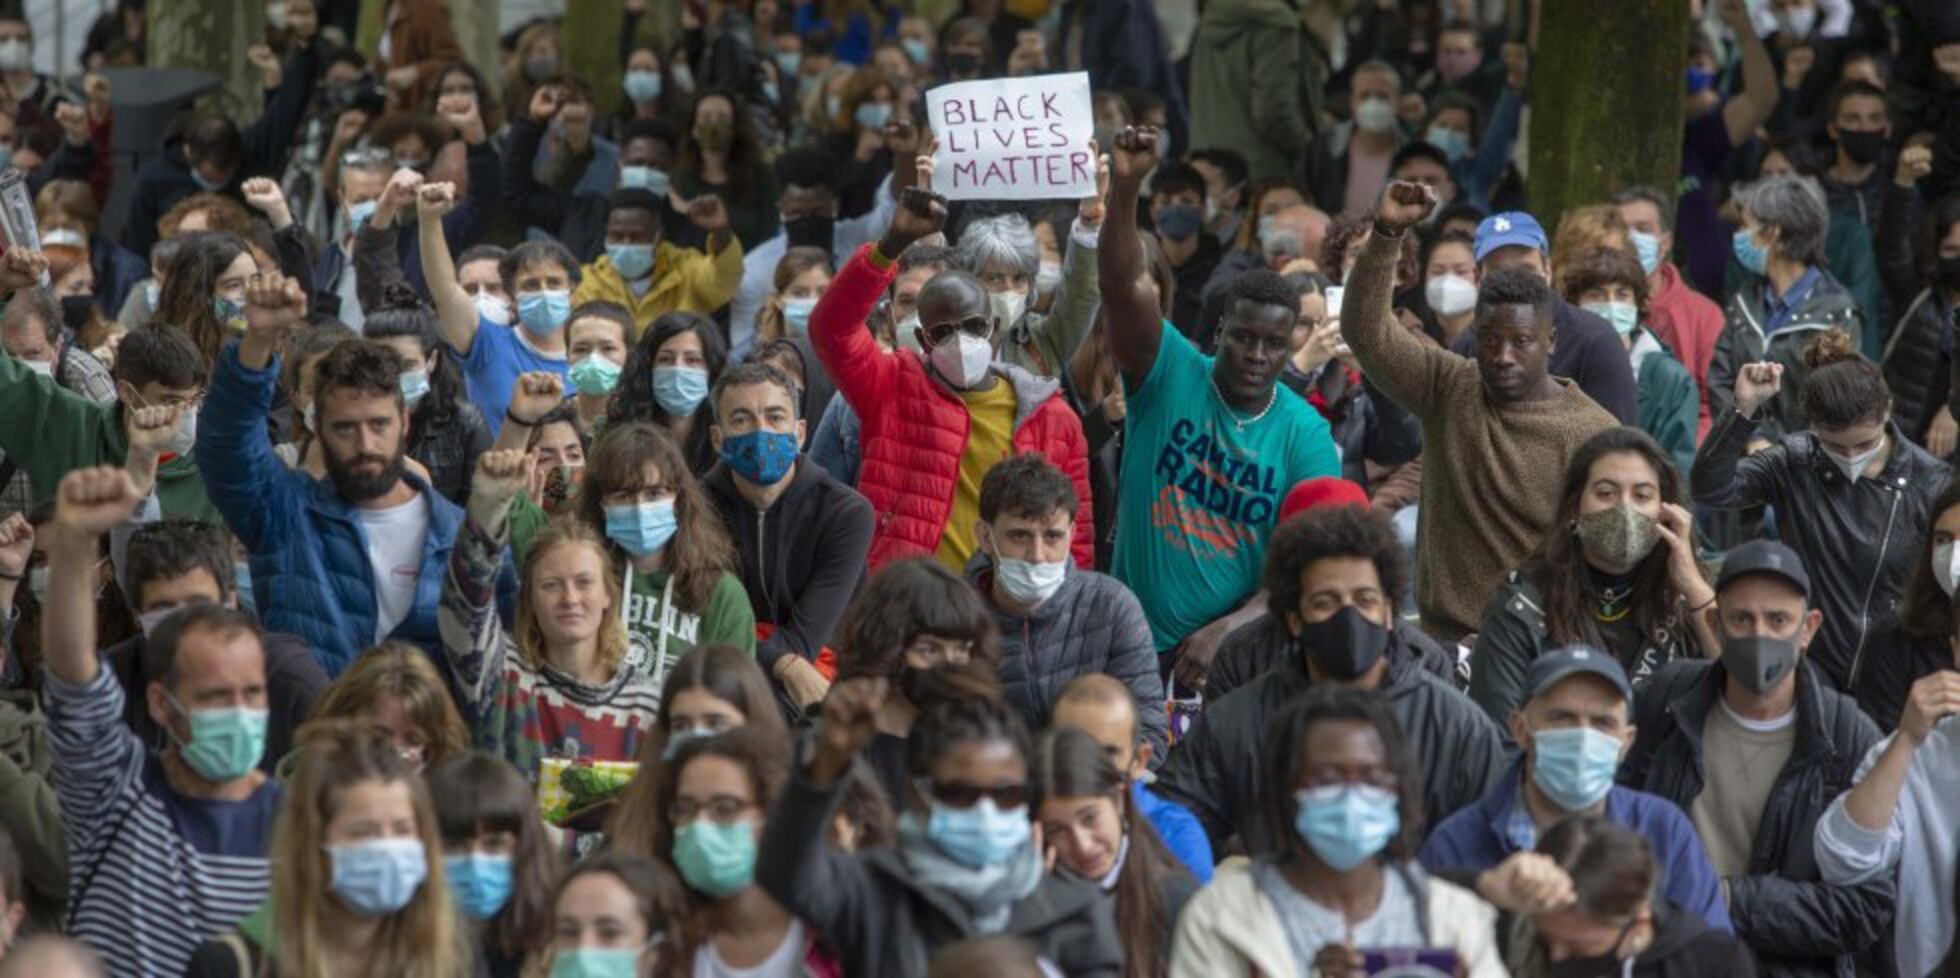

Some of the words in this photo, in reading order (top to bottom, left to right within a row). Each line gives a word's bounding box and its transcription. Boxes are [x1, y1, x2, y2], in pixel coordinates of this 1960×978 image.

[943, 91, 1063, 125] BLACK
[949, 123, 1069, 152] LIVES
[953, 151, 1090, 188] MATTER
[1155, 442, 1273, 525] RADIO
